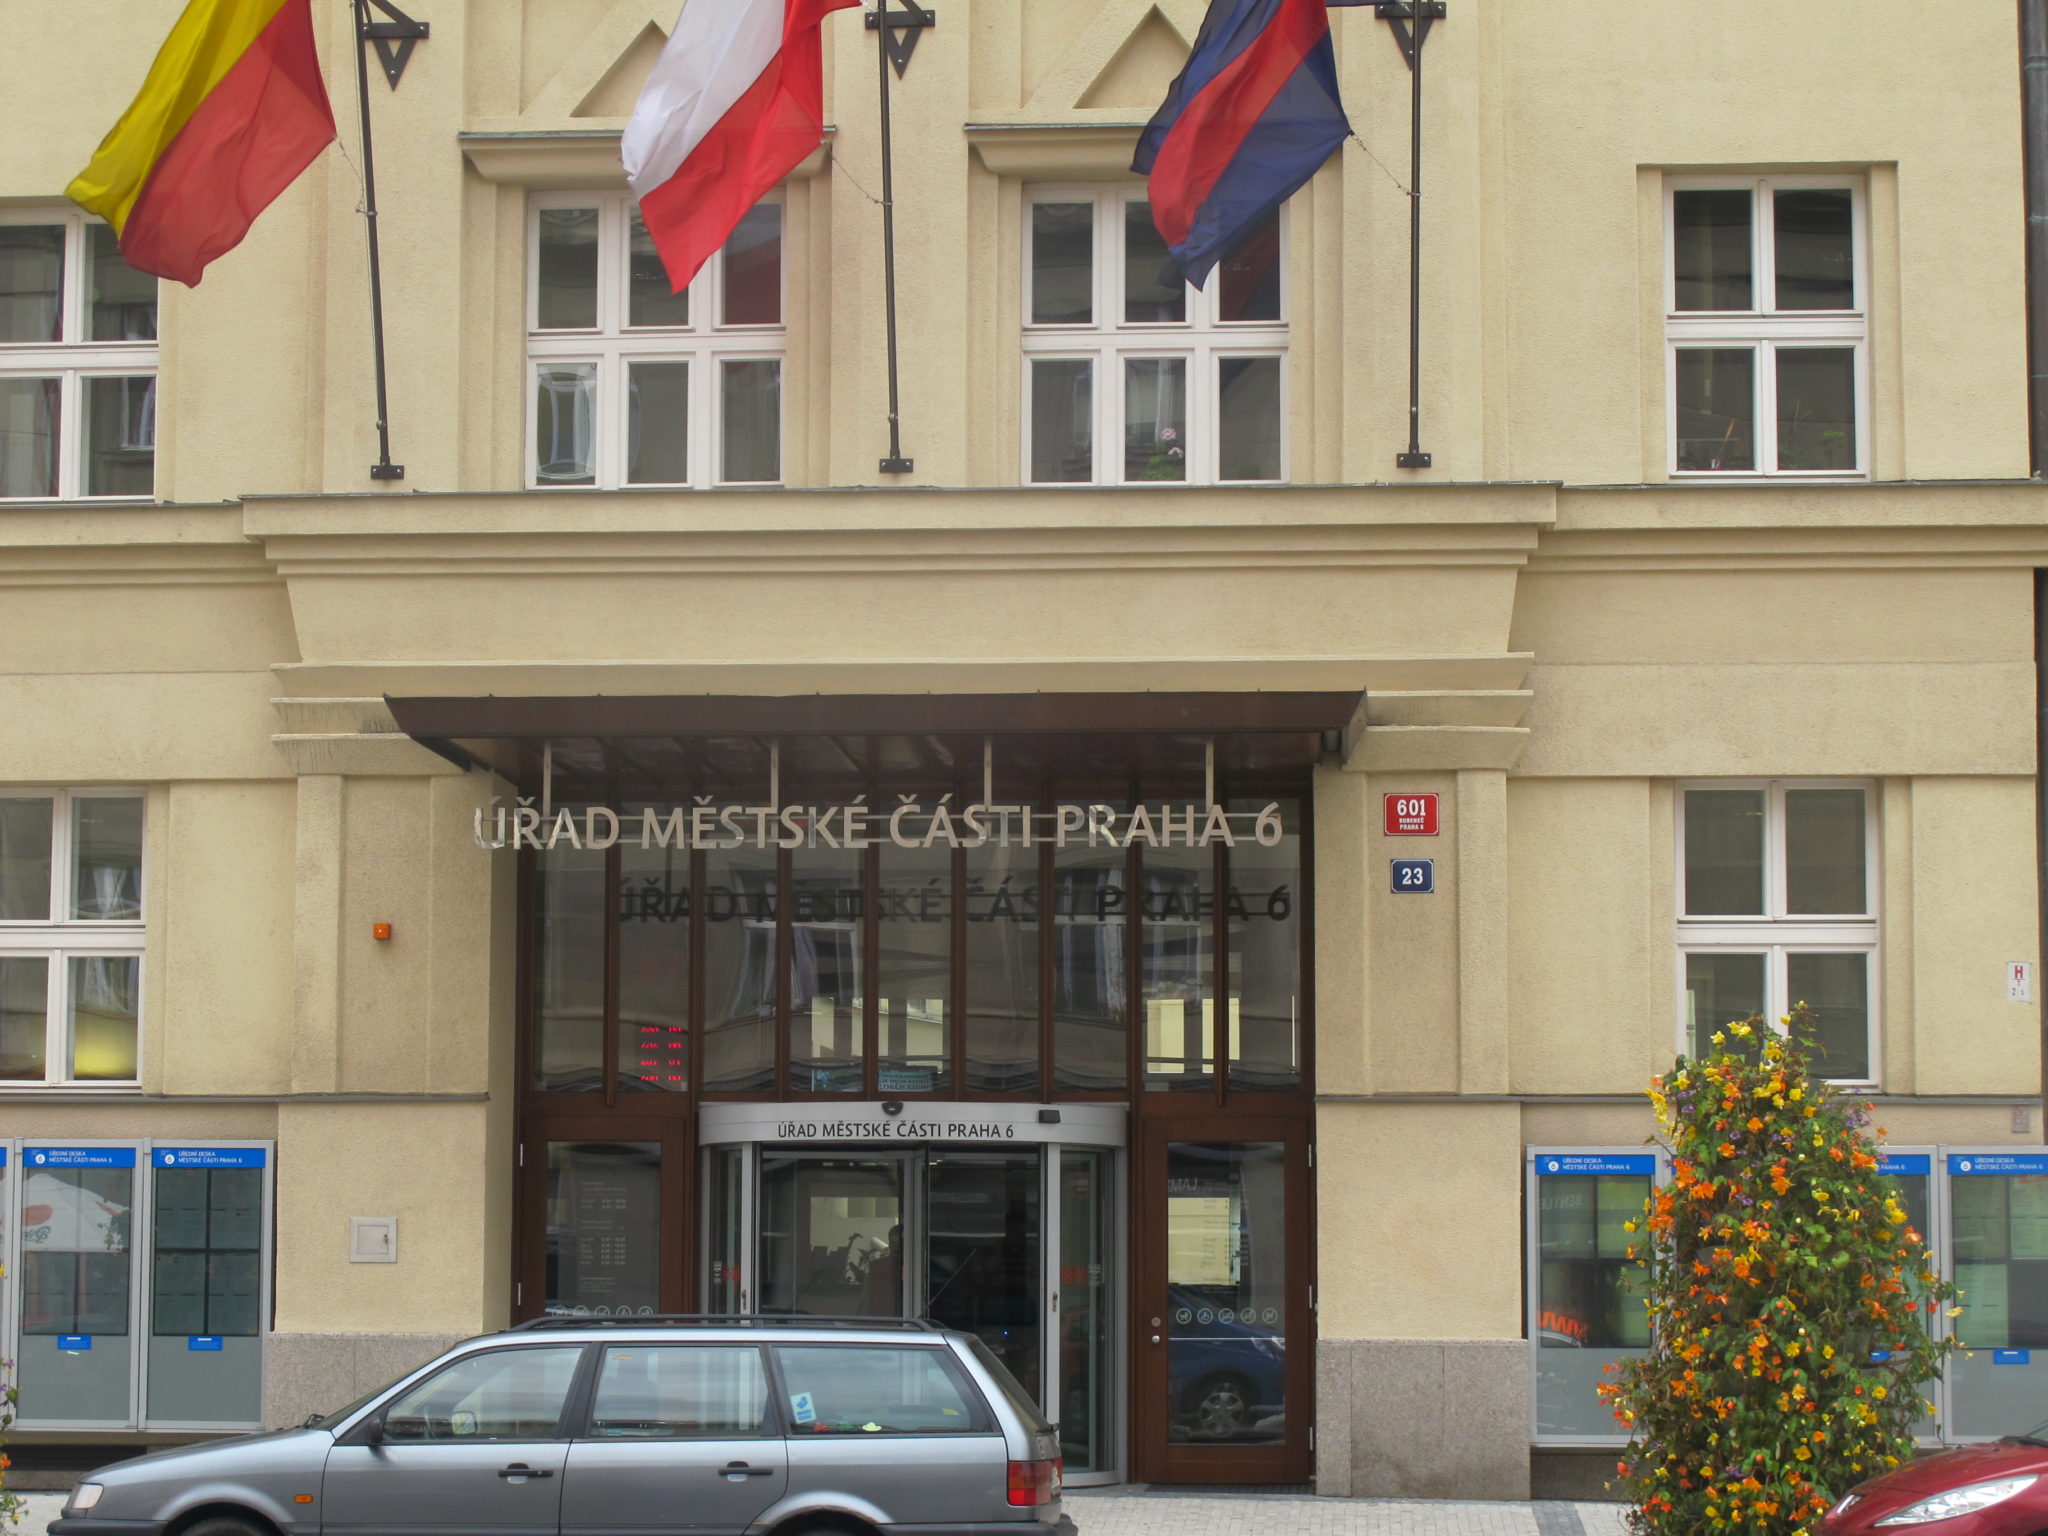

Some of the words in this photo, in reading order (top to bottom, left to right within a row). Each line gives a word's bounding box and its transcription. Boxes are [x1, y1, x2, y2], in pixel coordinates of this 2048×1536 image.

[1397, 799, 1426, 816] 601
[474, 796, 620, 850] ÚŘAD
[641, 794, 869, 850] MĚSTSKÉ
[889, 793, 1031, 848] ČÁSTI
[1056, 804, 1236, 848] PRAHA
[1254, 801, 1284, 848] 6
[1401, 867, 1424, 885] 23
[2014, 965, 2024, 979] H
[778, 1120, 817, 1138] ÚŘAD
[822, 1119, 891, 1137] MĚSTSKÉ
[896, 1120, 941, 1137] ČÁSTI
[948, 1123, 1001, 1138] PRAHA
[1005, 1123, 1014, 1138] 6
